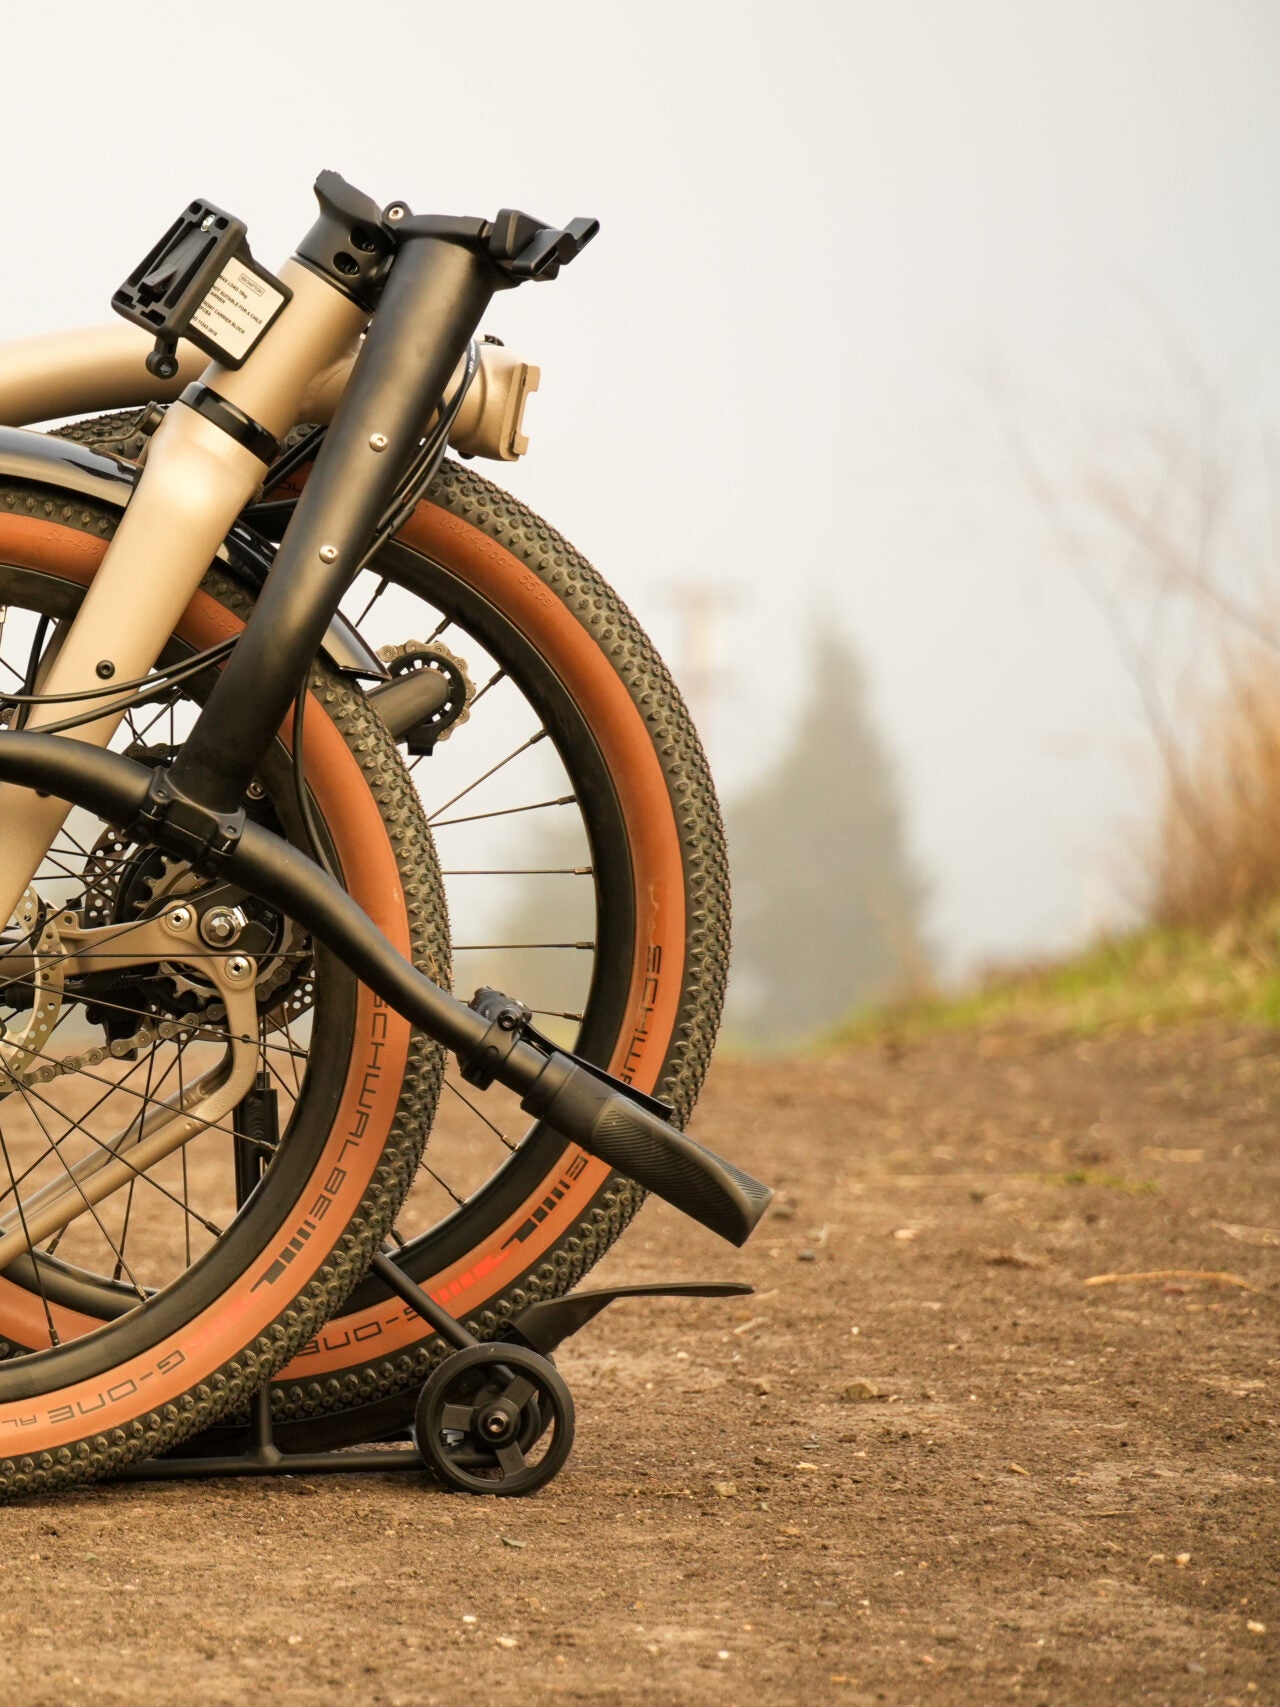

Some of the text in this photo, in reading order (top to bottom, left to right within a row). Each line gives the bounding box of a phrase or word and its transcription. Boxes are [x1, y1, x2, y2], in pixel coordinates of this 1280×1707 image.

[218, 275, 228, 283] MAX
[227, 282, 239, 290] LOAD
[209, 290, 226, 304] CARRIER
[221, 290, 239, 306] SUITABLE
[239, 304, 248, 313] FOR
[250, 314, 262, 324] CHILD
[214, 308, 232, 324] CARRIER
[231, 322, 245, 333] BLOCK
[47, 1349, 186, 1425] G-ONE
